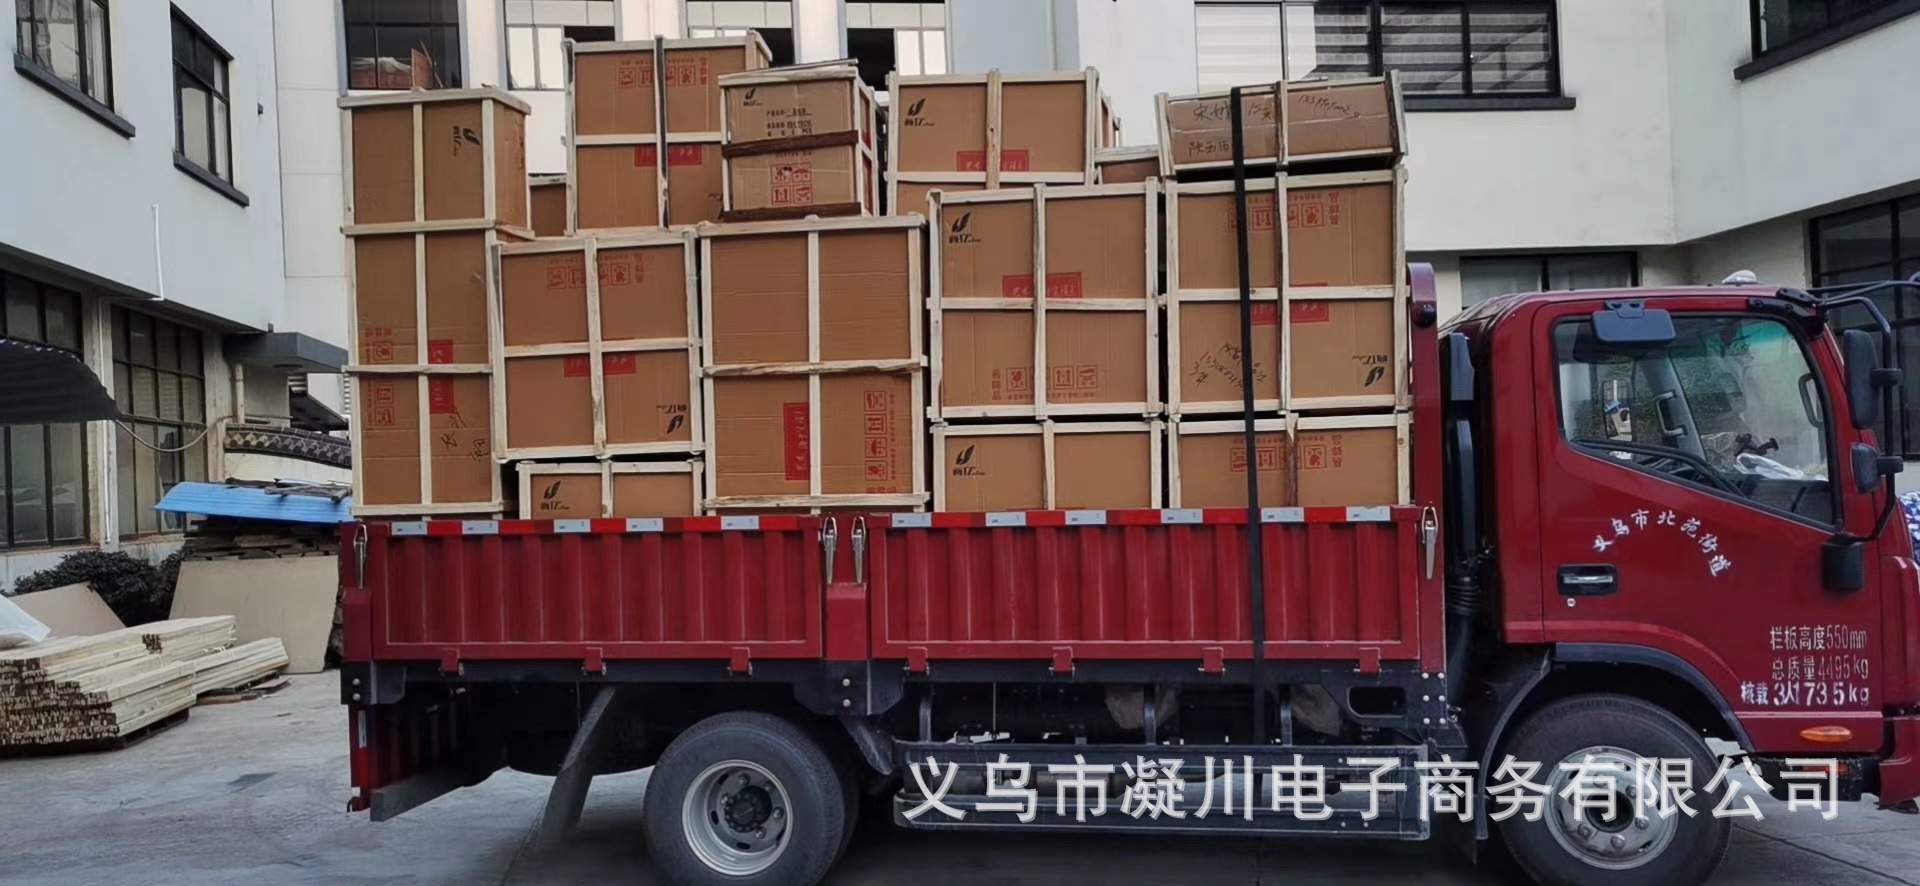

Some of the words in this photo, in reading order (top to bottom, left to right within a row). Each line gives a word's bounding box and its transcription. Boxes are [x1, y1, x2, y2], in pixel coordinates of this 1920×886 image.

[1593, 508, 1732, 577] 义乌市北苑街道
[1769, 625, 1867, 651] 栏板高度550mm
[1772, 655, 1869, 680] 总质量4495kg
